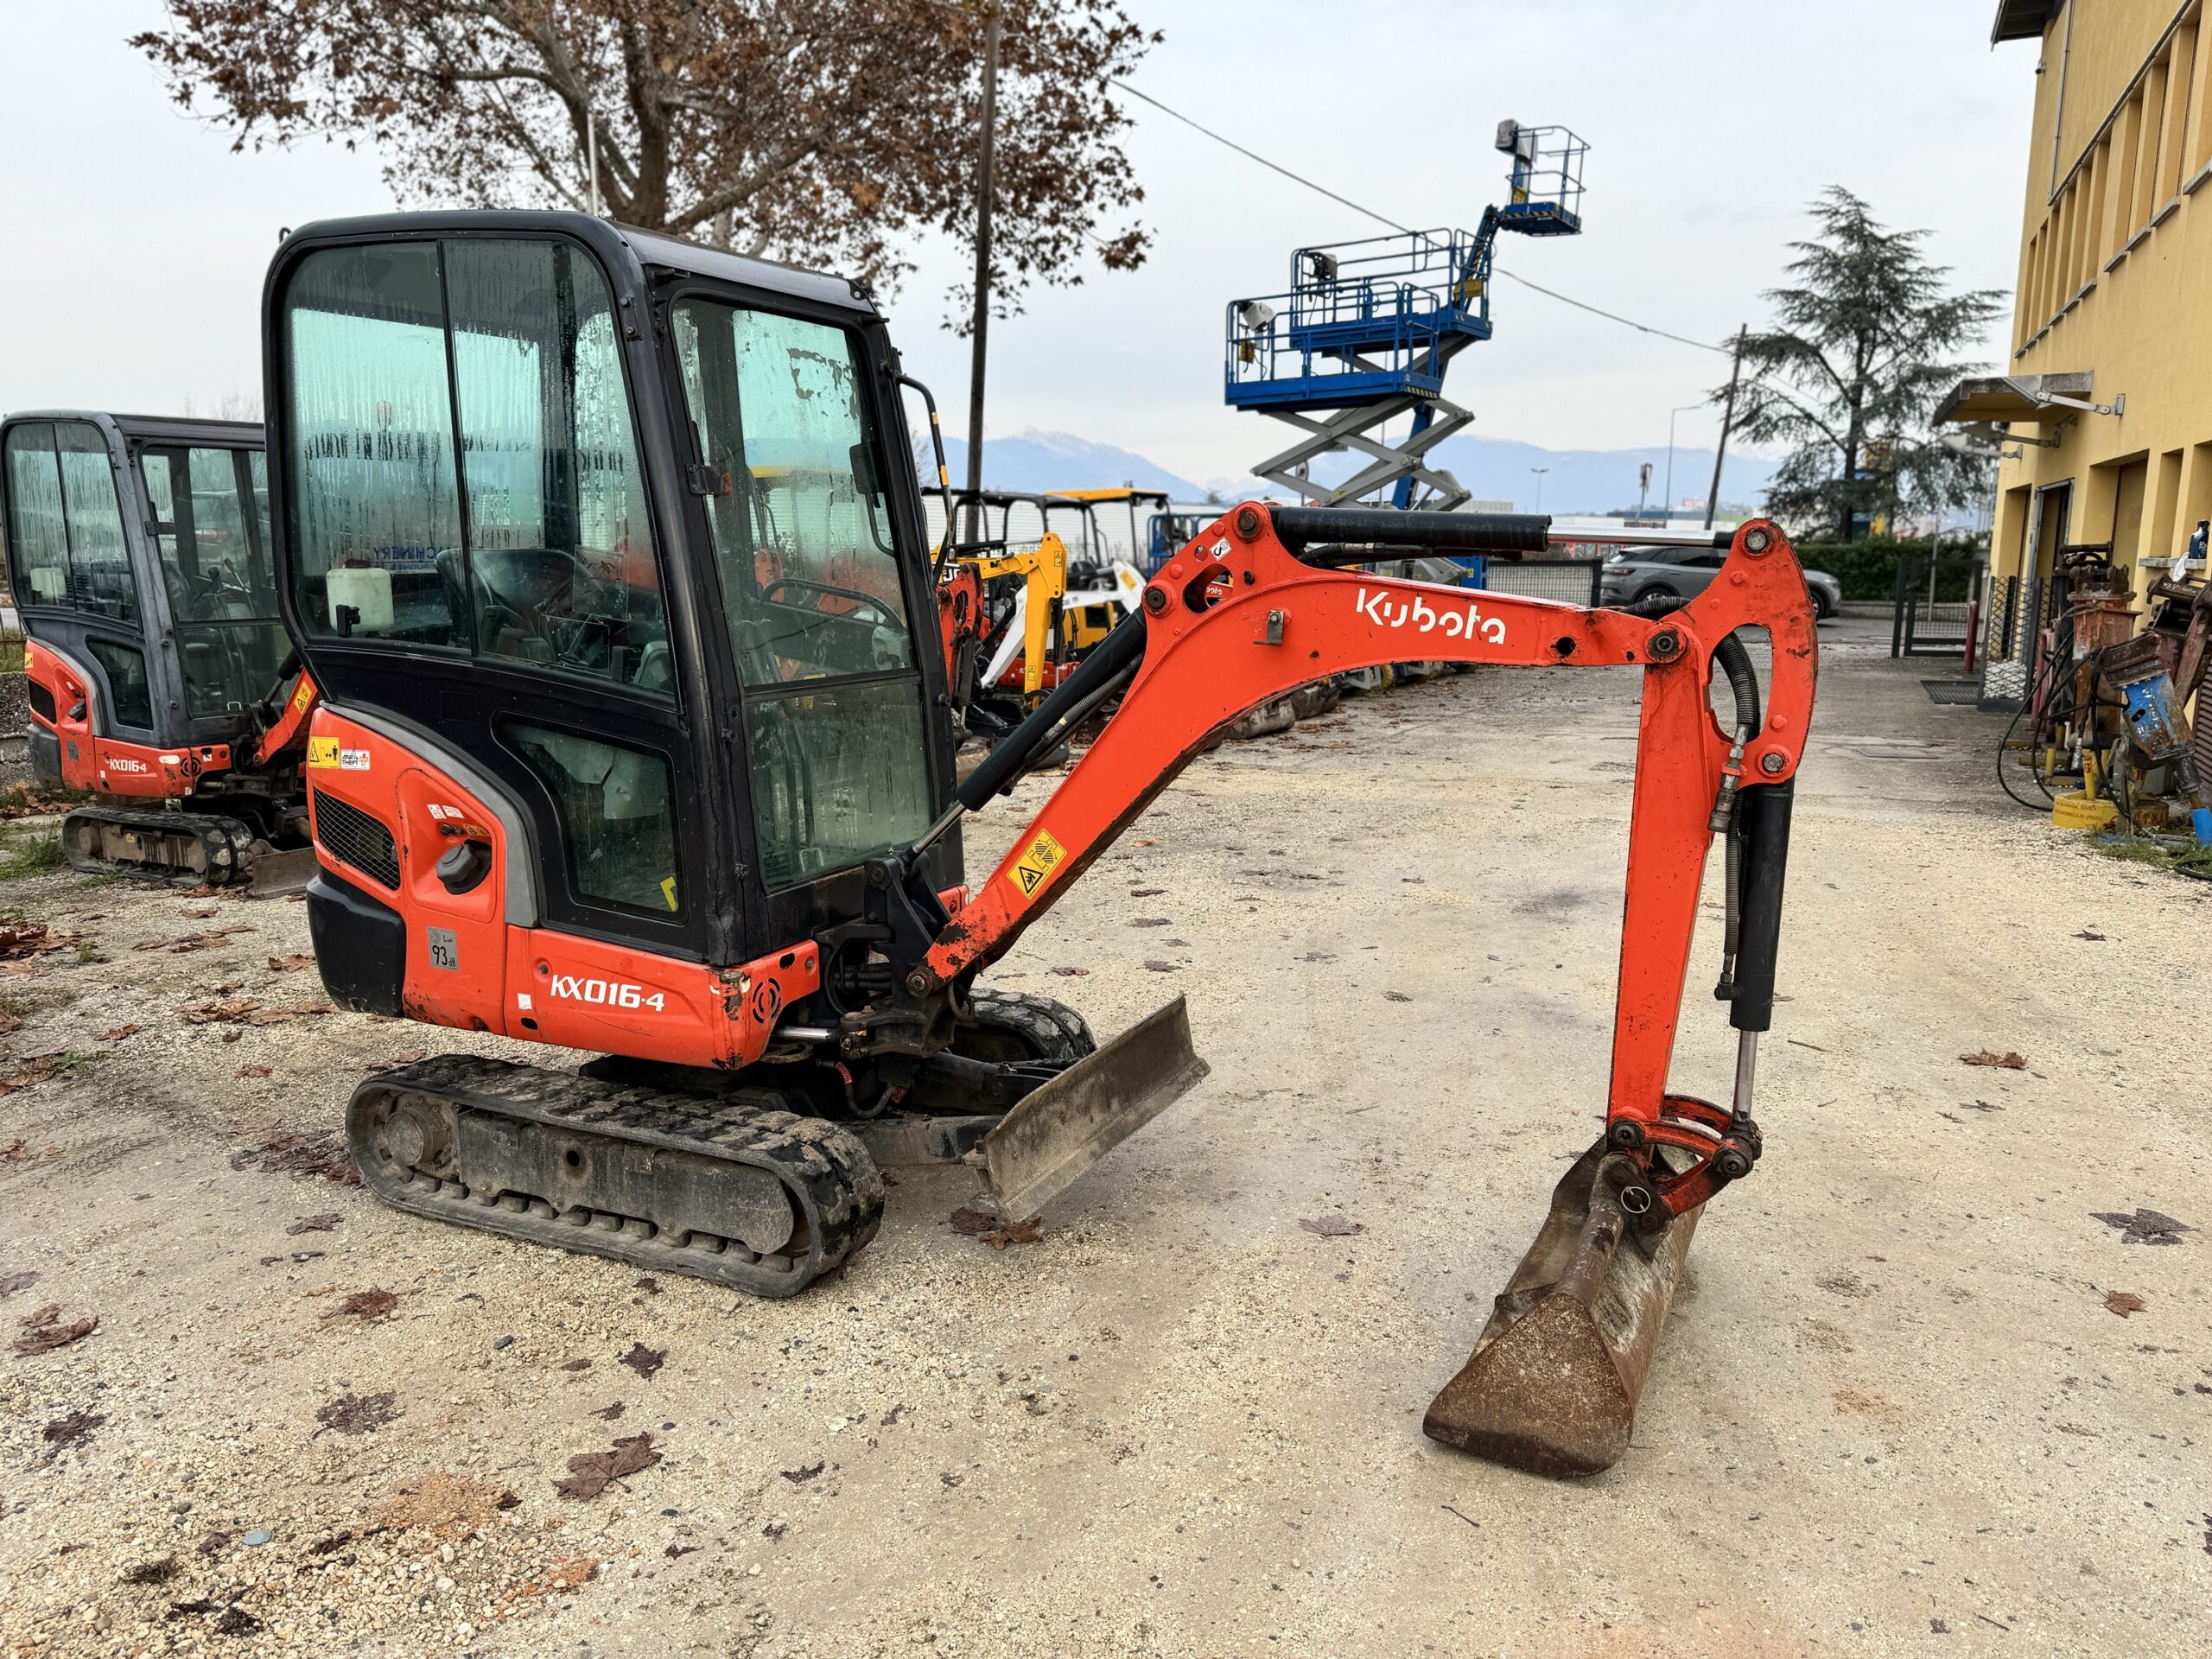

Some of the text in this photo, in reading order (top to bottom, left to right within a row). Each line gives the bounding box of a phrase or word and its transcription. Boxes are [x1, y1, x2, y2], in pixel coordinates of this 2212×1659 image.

[943, 568, 961, 582] JC
[1356, 588, 1507, 645] Kubota
[110, 759, 147, 772] KX016-4
[432, 944, 456, 967] 93 dB
[550, 974, 665, 1012] KX016-4
